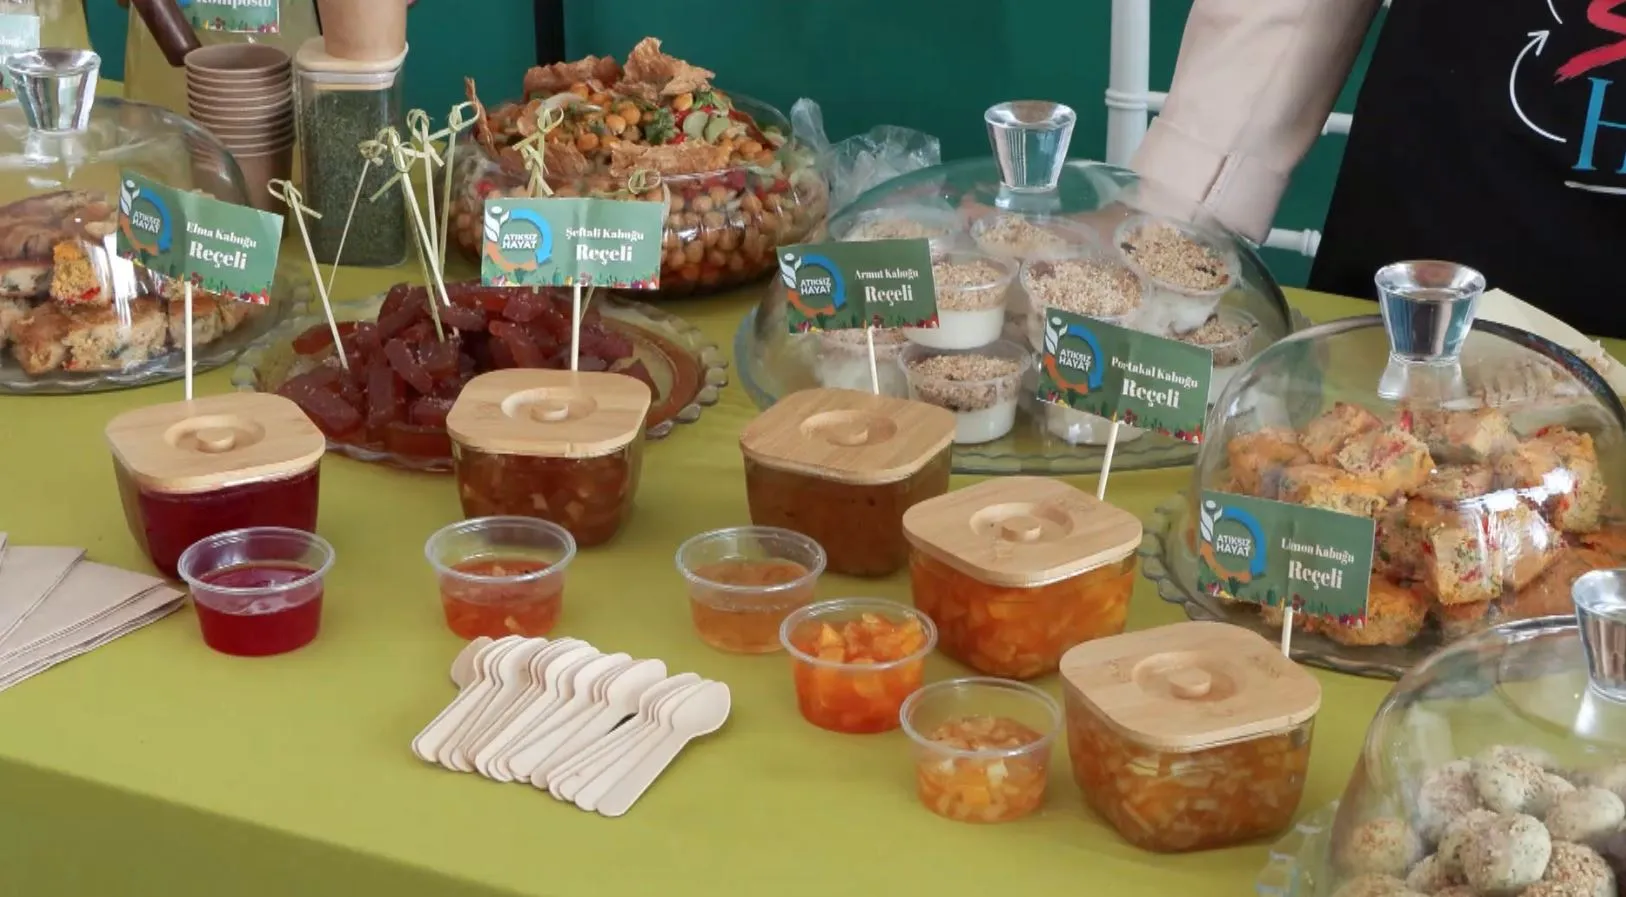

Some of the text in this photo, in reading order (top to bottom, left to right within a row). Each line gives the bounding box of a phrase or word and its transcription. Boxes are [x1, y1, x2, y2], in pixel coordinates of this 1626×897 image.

[132, 216, 161, 234] HAYAT
[186, 221, 257, 249] Elma Kabuğu
[503, 233, 538, 241] ATIKSIZ
[566, 227, 644, 241] Şeftali Kabuğu
[502, 240, 538, 249] HAYAT
[189, 240, 248, 270] Reçeli
[576, 244, 633, 265] Reçeli
[800, 277, 832, 287] ATIKSIZ
[854, 267, 919, 280] Armut Kabuğu
[801, 285, 831, 296] HAYAT
[864, 284, 914, 307] Reçeli
[1058, 356, 1091, 373] HAYAT
[1060, 348, 1092, 364] ATIKSIZ
[1111, 356, 1199, 389] Portakal Kabuğu
[1122, 378, 1180, 409] Reçeli
[1216, 534, 1252, 546] ATIKSIZ
[1216, 542, 1250, 557] HAYAT
[1281, 537, 1355, 566] Limon Kabuğu
[1287, 560, 1344, 590] Reçeli
